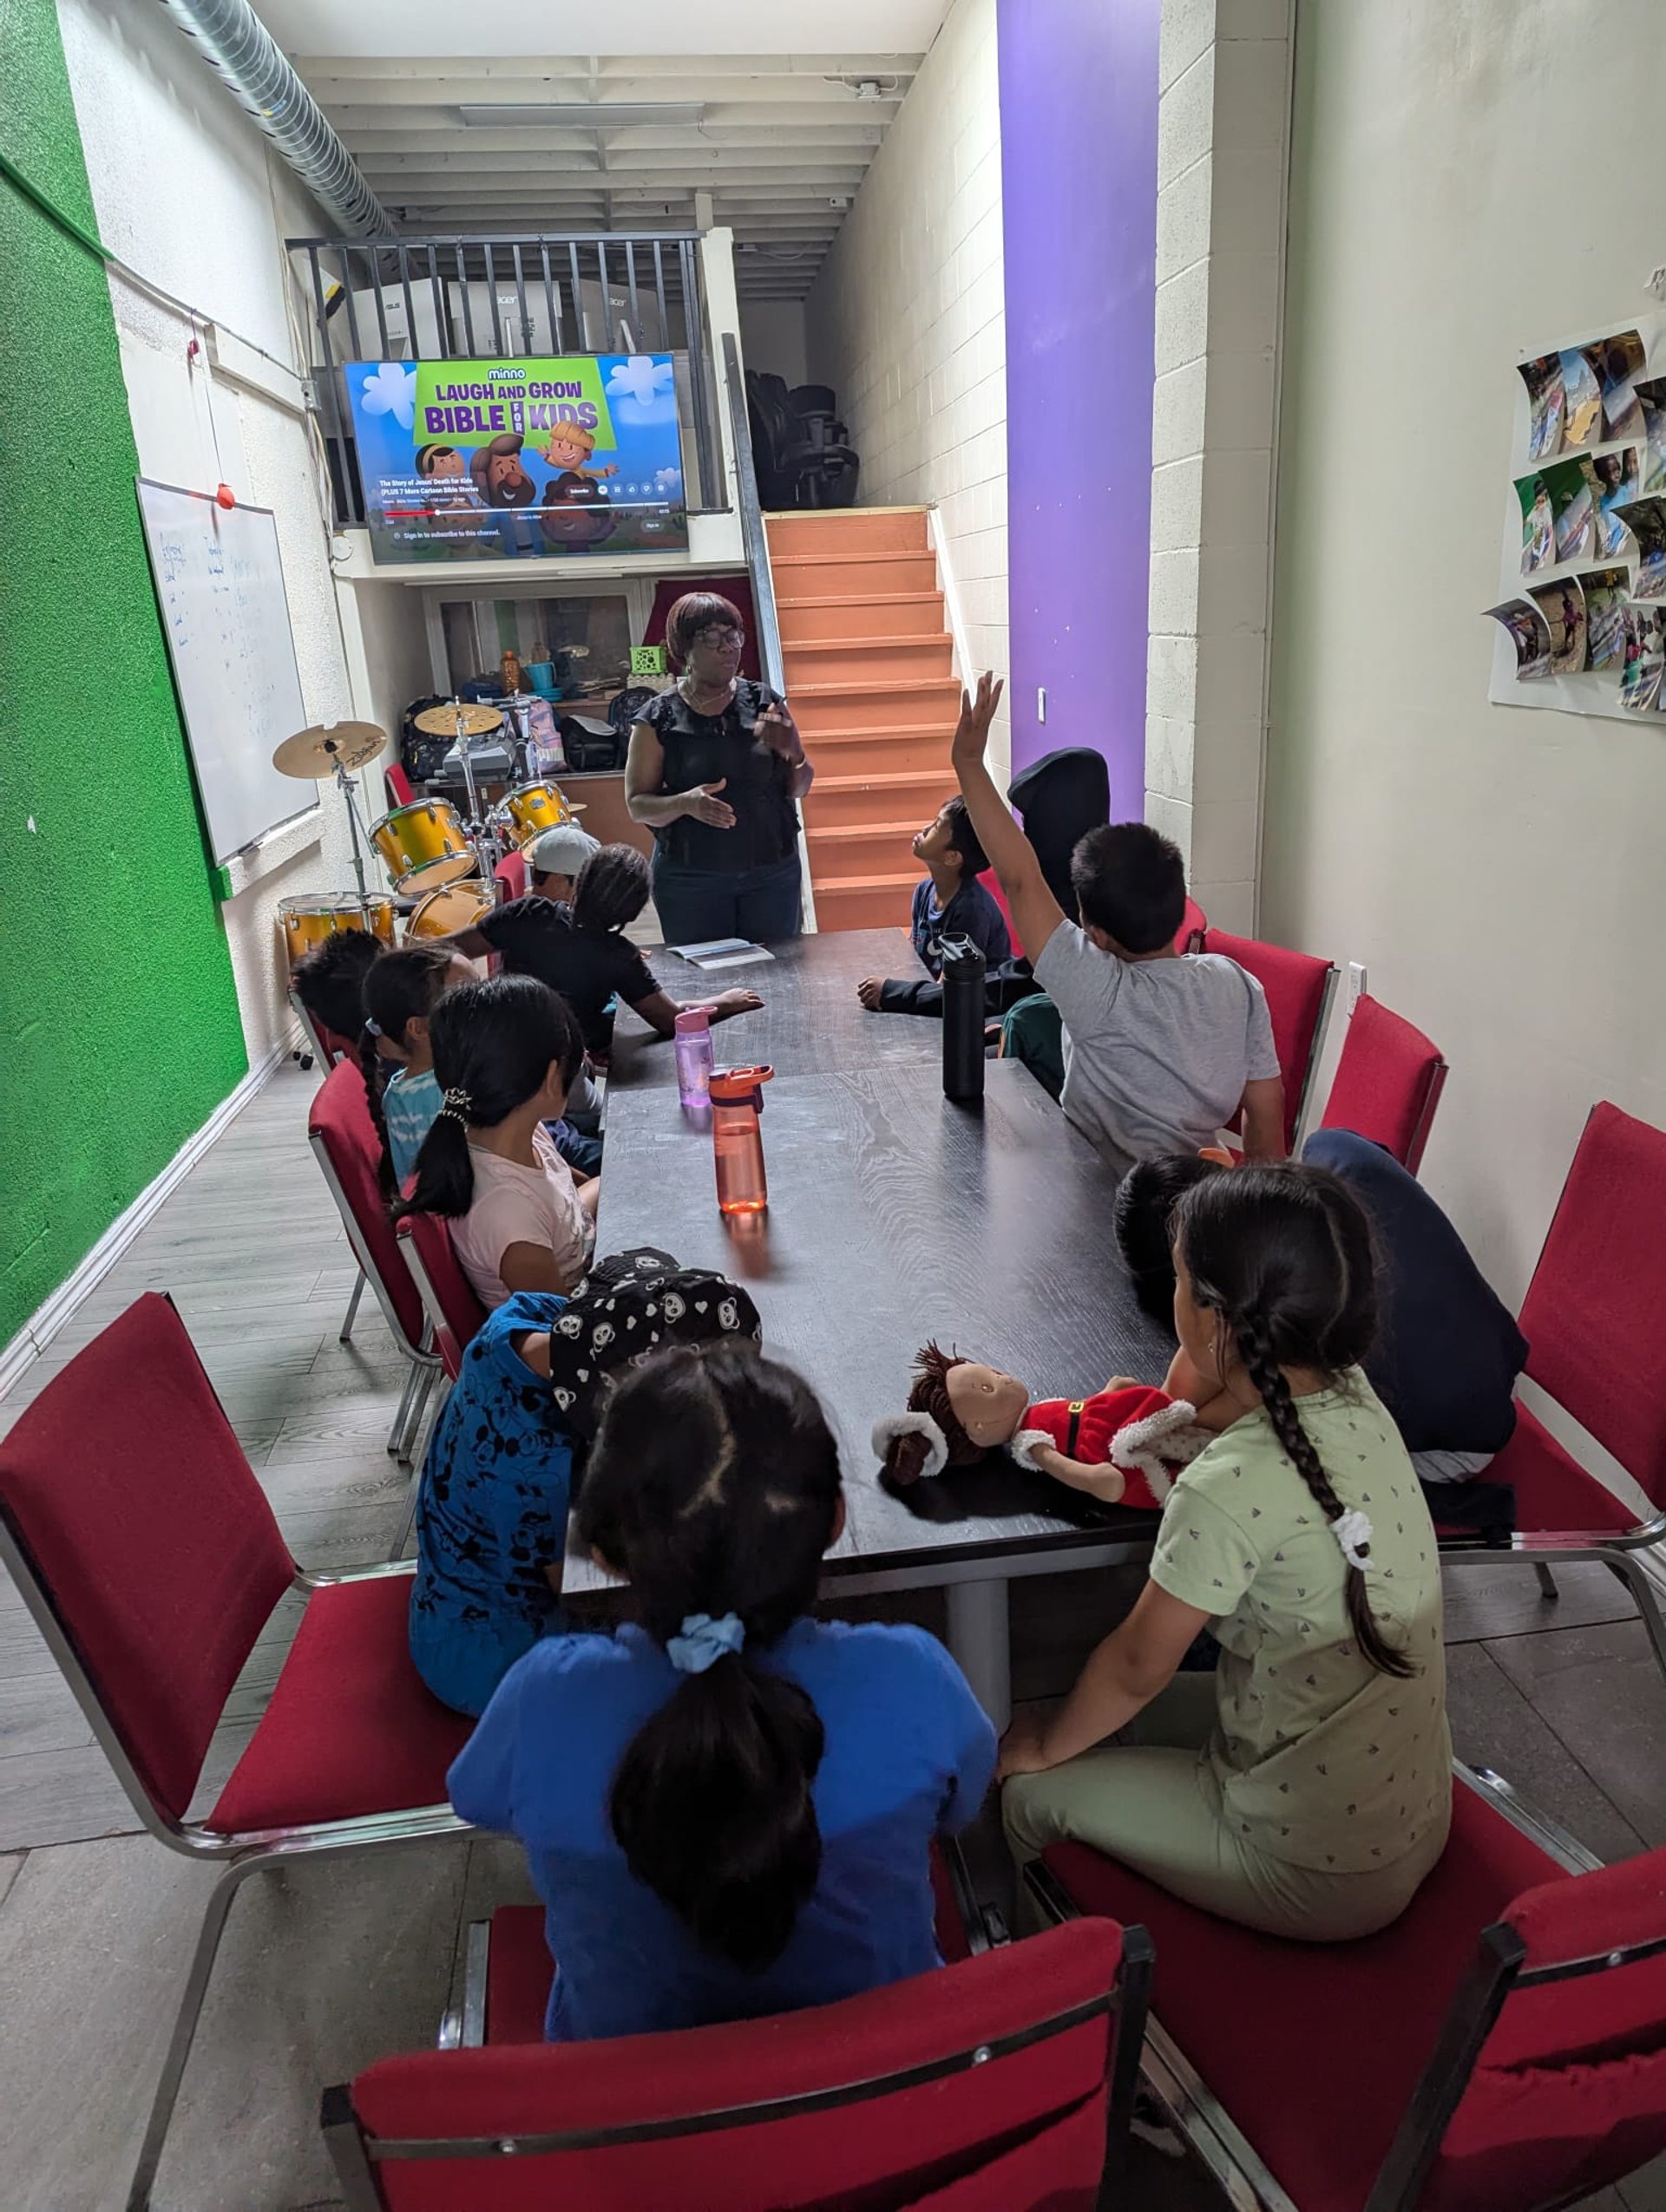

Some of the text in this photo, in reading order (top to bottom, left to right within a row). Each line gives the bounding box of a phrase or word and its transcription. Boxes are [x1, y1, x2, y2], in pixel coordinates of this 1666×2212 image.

[488, 367, 526, 380] minno
[436, 381, 582, 401] LAUGH AND GROW
[424, 402, 599, 434] BIBLE FOR KIDS
[391, 479, 407, 488] Story
[403, 532, 416, 540] Sign
